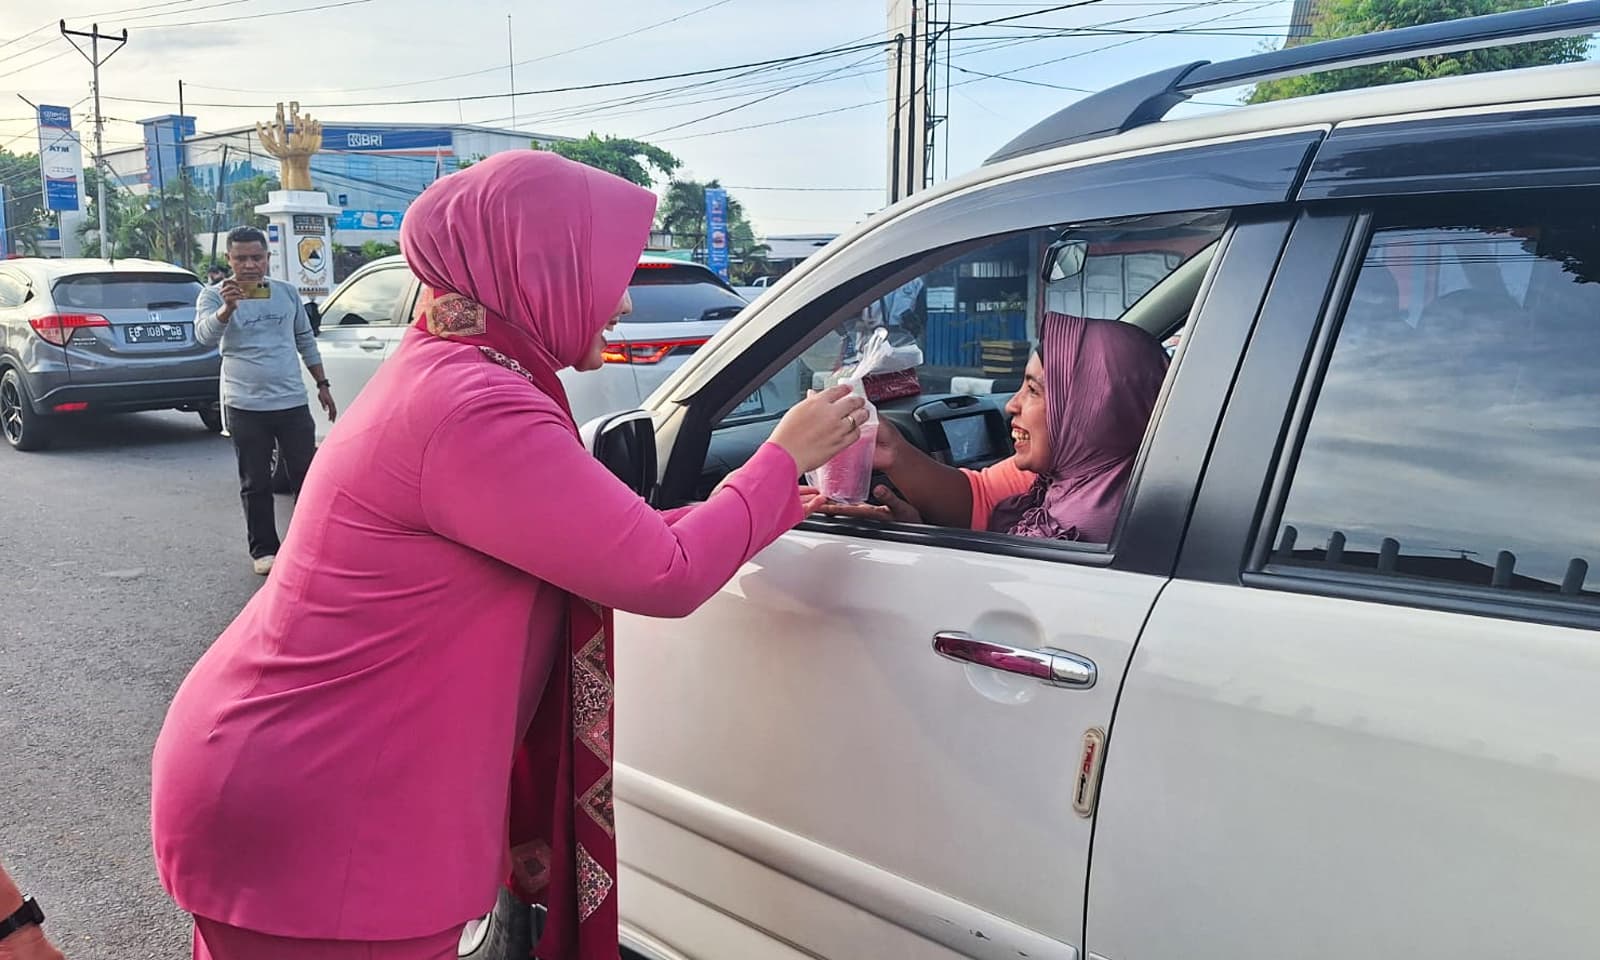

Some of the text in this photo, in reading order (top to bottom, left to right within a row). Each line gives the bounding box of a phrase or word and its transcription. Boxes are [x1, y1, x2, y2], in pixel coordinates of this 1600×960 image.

[361, 133, 383, 147] BRI
[49, 145, 70, 153] ATM
[128, 327, 141, 338] EB
